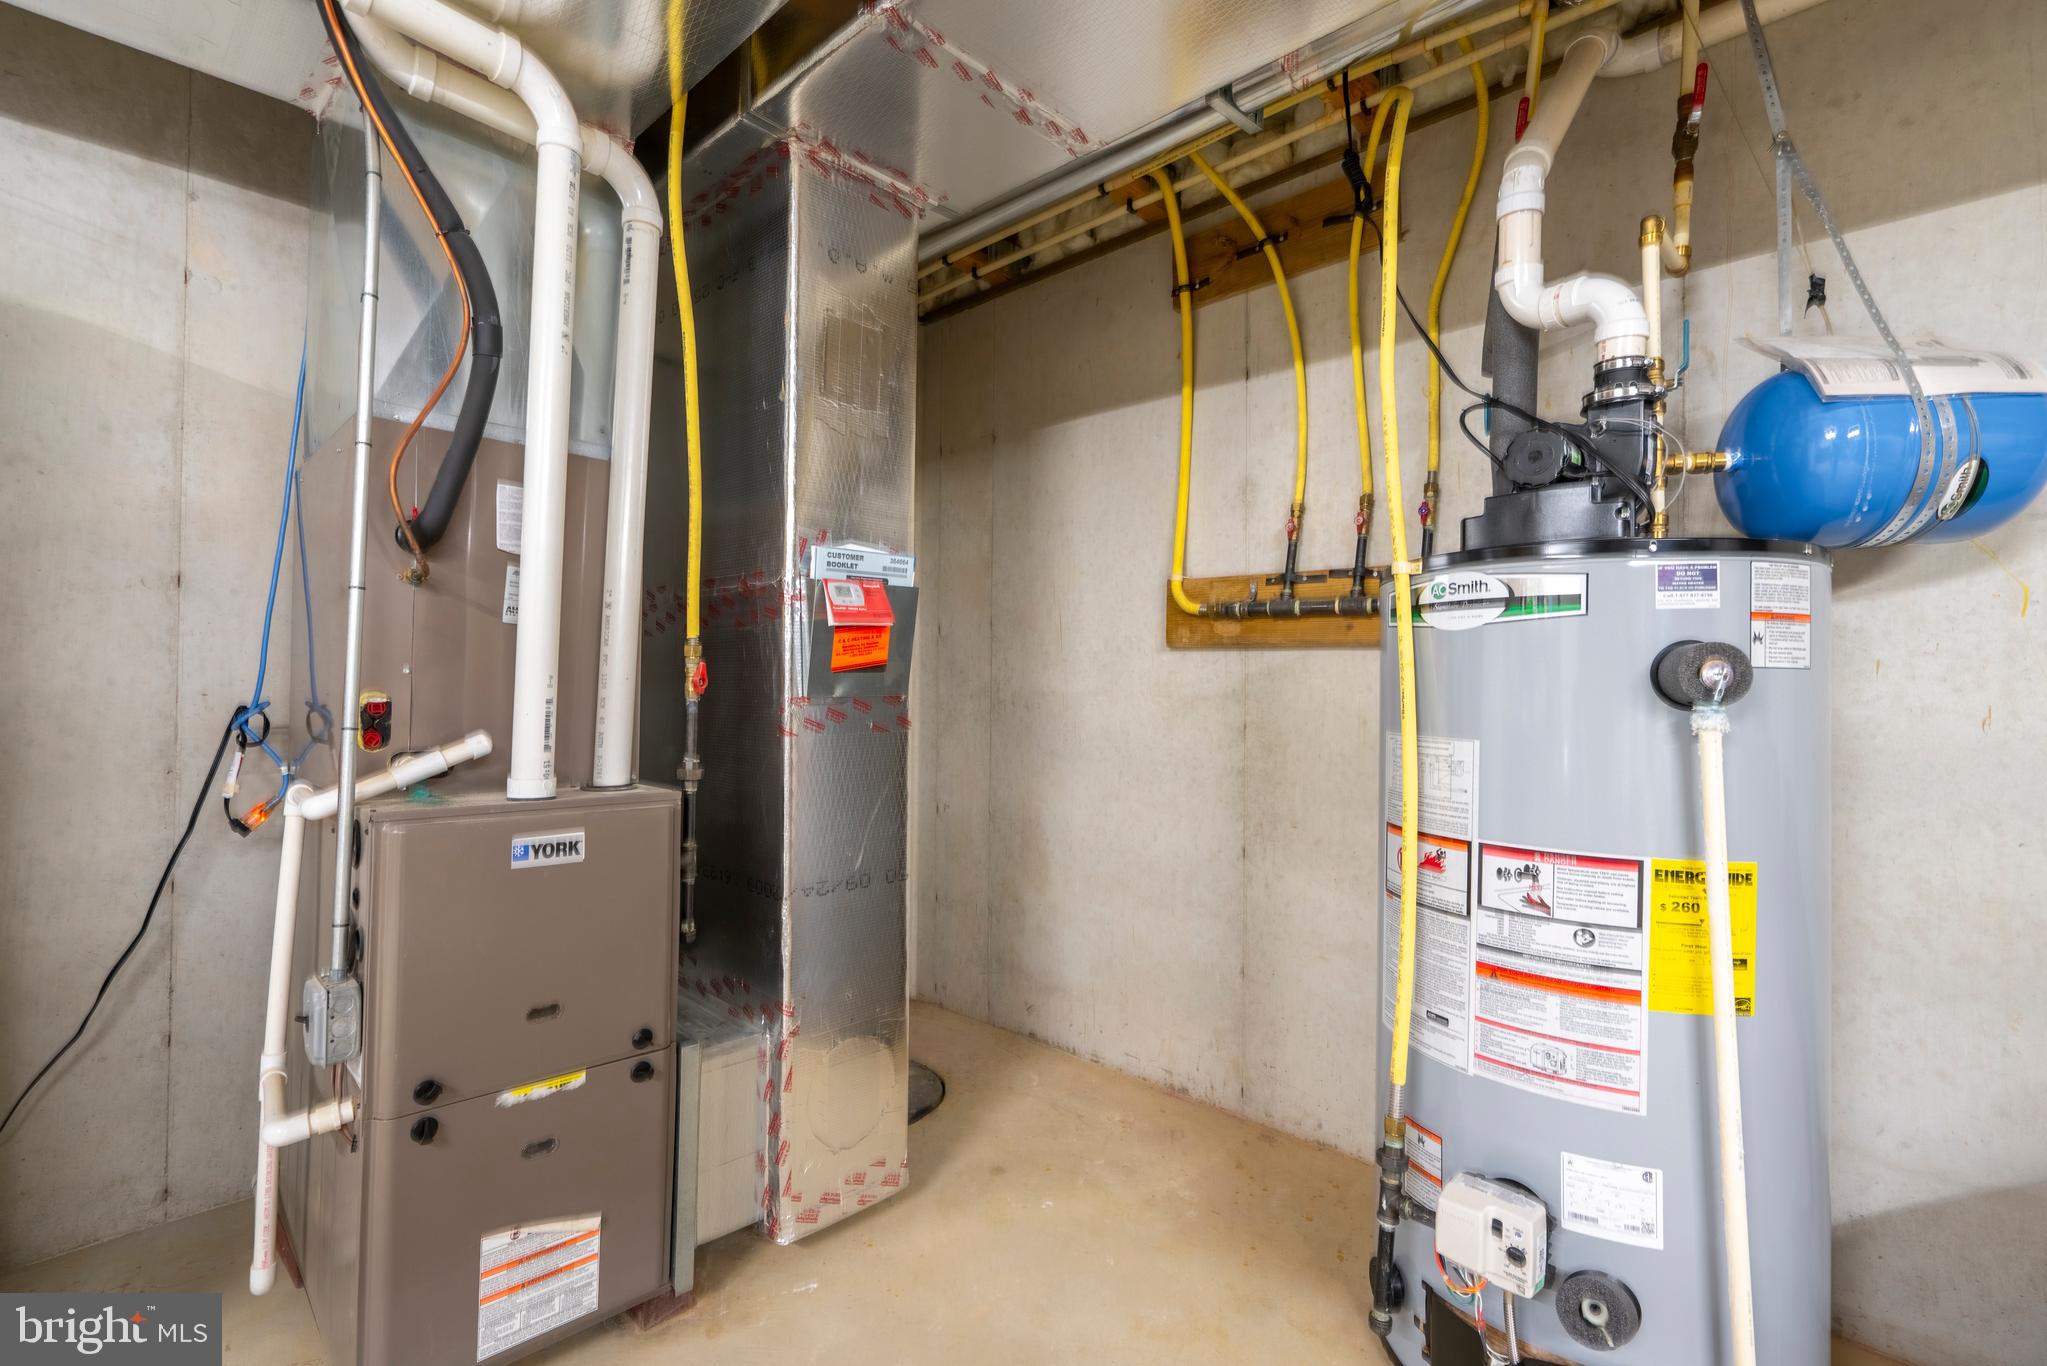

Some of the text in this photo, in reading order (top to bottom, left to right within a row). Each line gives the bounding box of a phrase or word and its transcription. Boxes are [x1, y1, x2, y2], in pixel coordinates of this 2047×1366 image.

[827, 552, 864, 561] CUSTOMER
[827, 561, 858, 569] BOOKLET
[531, 840, 581, 859] YORK
[1672, 901, 1700, 913] 260
